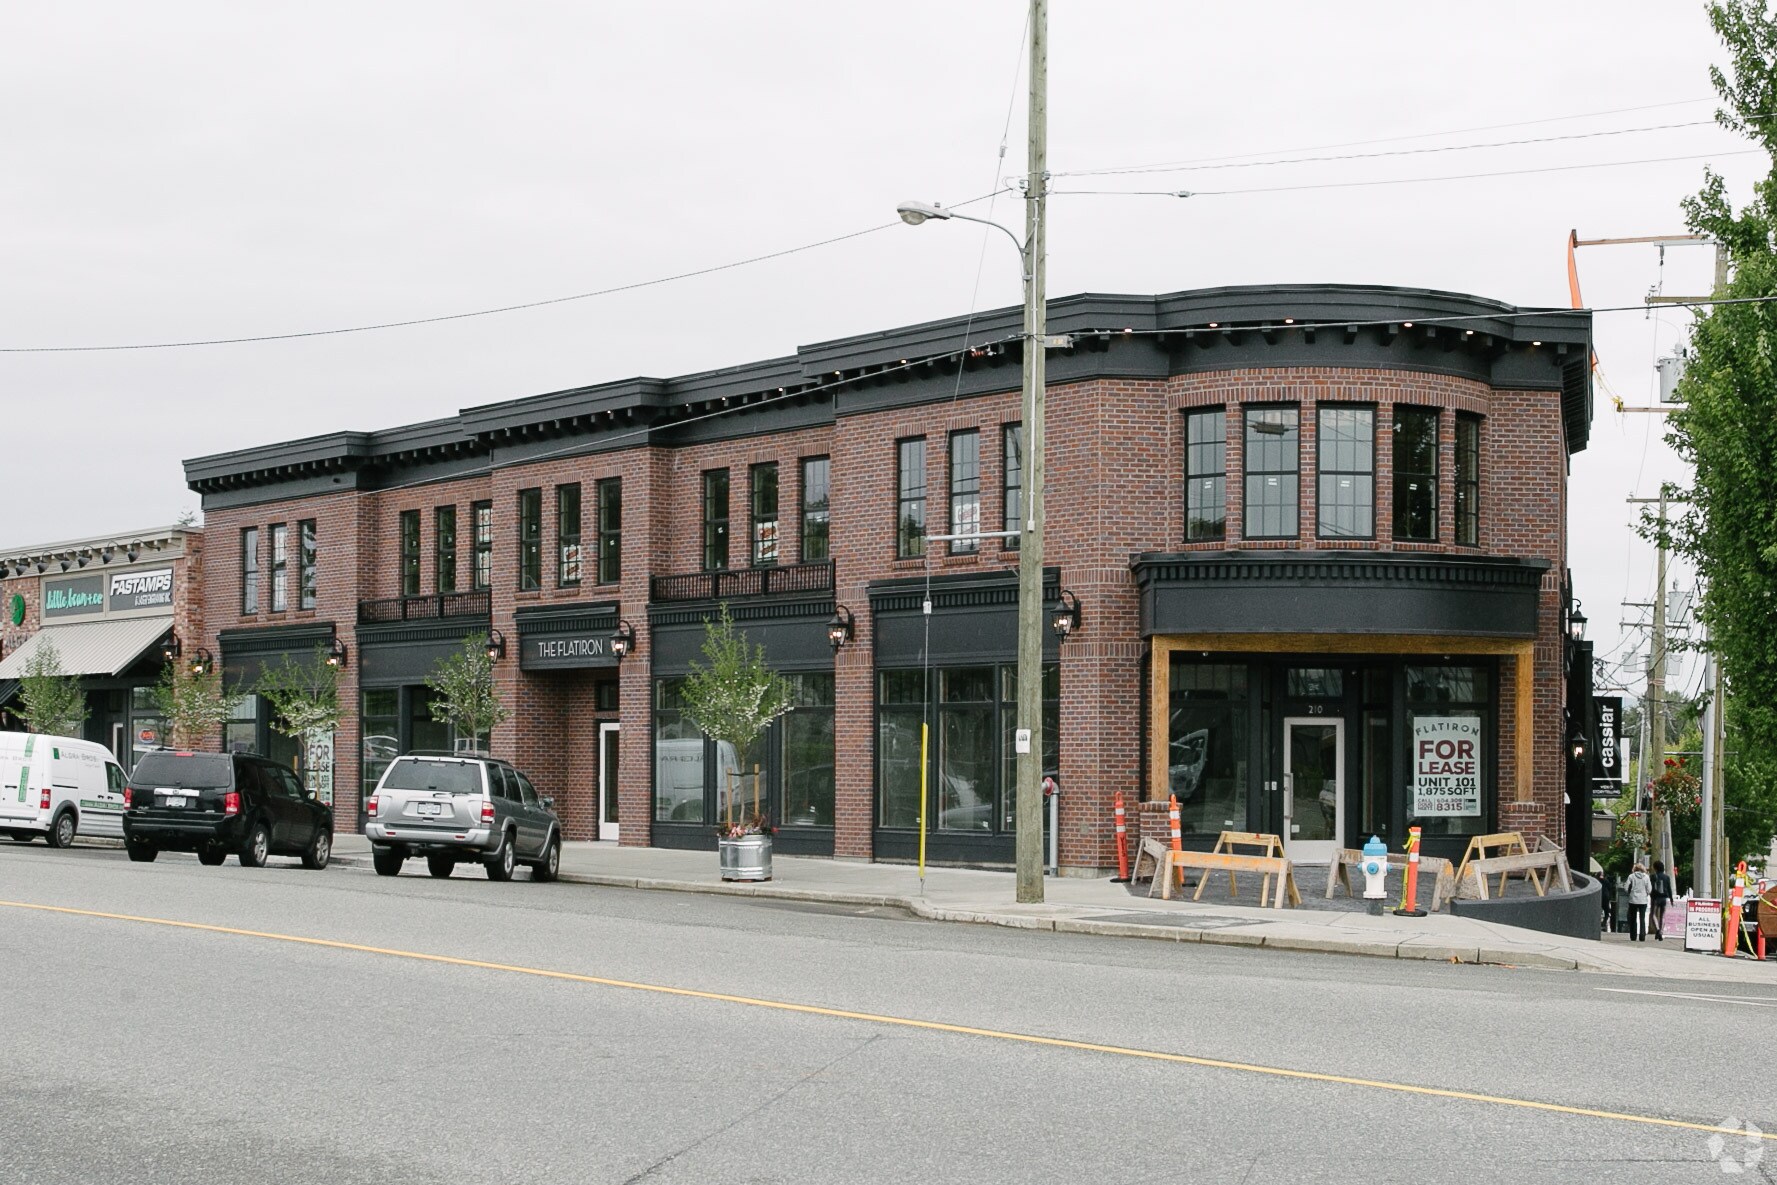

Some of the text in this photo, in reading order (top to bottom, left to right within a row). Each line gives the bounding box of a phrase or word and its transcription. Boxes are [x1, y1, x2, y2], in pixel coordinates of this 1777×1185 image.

[110, 573, 172, 596] FASTAMPS
[538, 639, 603, 657] THE FLATIRON
[1308, 705, 1323, 714] 210
[1415, 722, 1479, 736] FLATIRON
[1599, 705, 1614, 768] cassiar
[309, 744, 330, 760] FOR
[1419, 739, 1475, 760] FOR
[1418, 761, 1476, 775] LEASE
[1418, 777, 1476, 787] UNIT 101
[1418, 787, 1446, 797] 1,875
[1436, 803, 1463, 811] 8315
